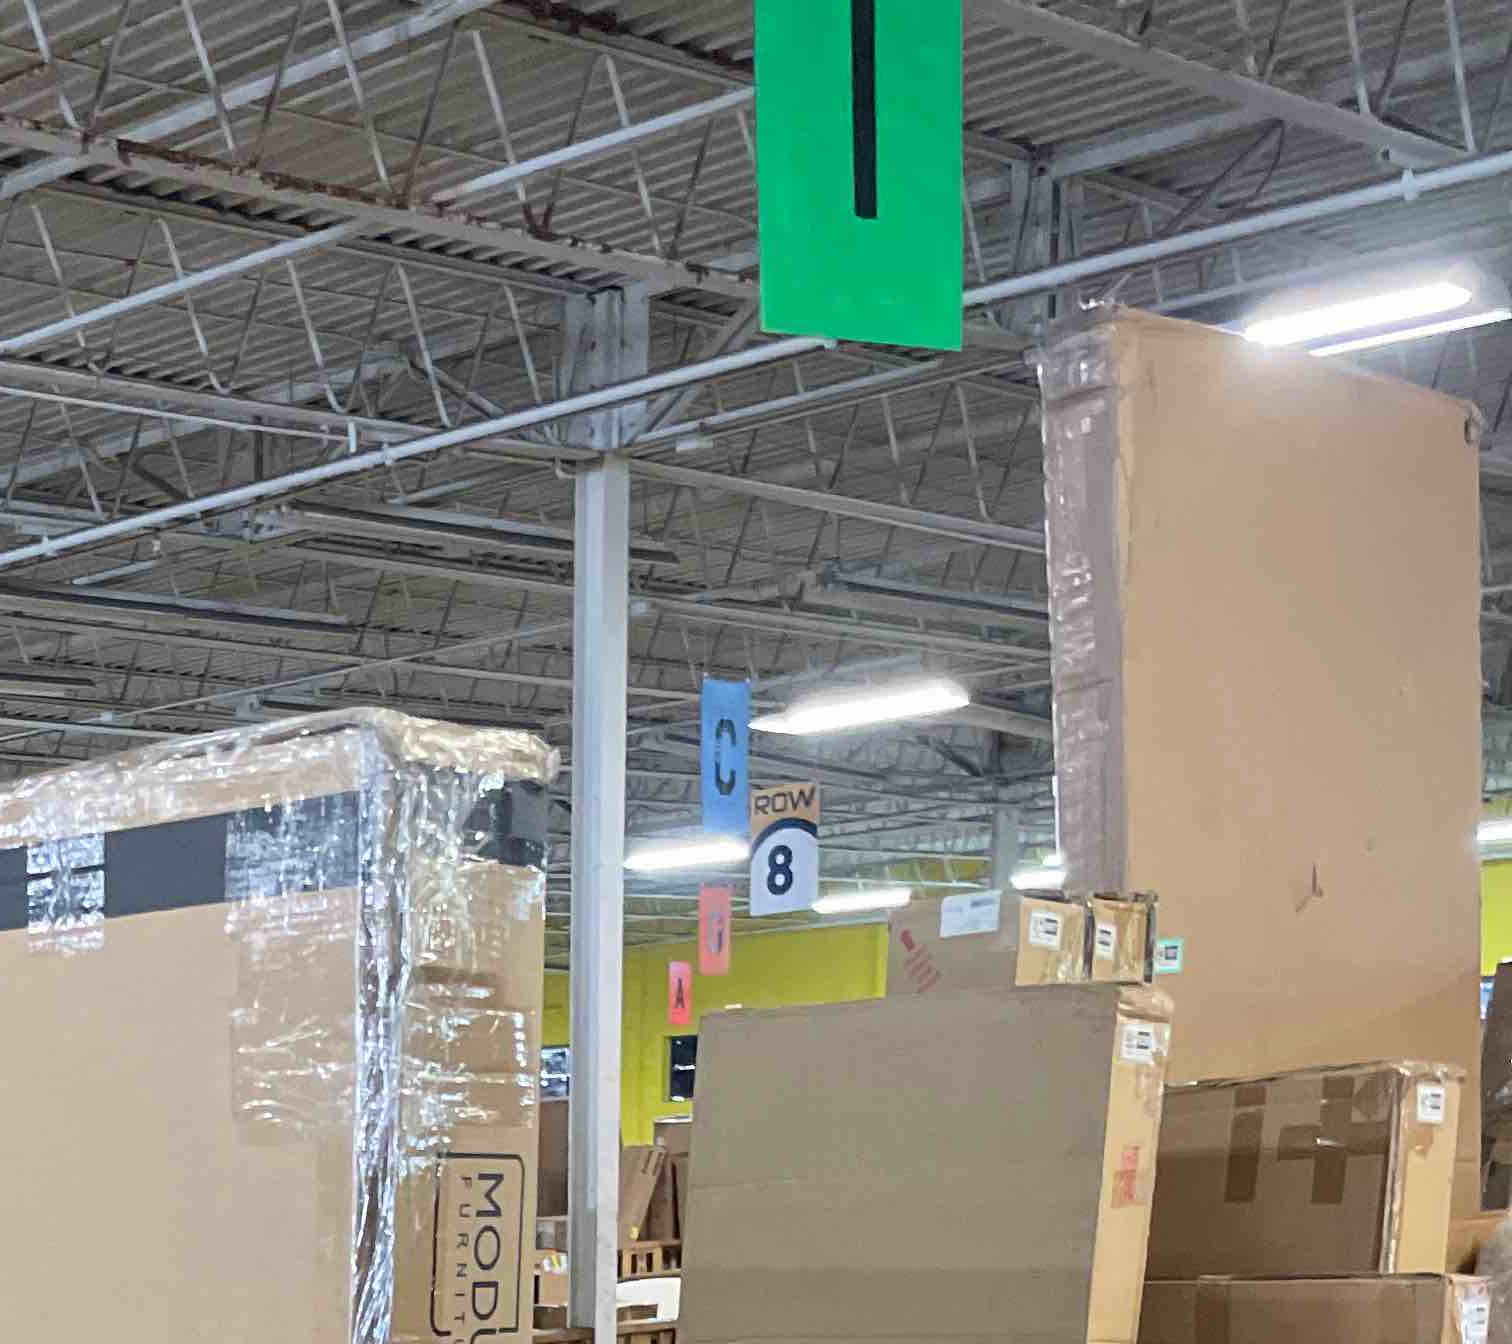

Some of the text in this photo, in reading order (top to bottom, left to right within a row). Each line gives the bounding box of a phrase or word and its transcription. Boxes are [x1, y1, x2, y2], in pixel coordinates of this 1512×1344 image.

[714, 718, 736, 795] C
[754, 786, 815, 816] ROW
[767, 844, 793, 895] 8
[675, 976, 686, 1009] A
